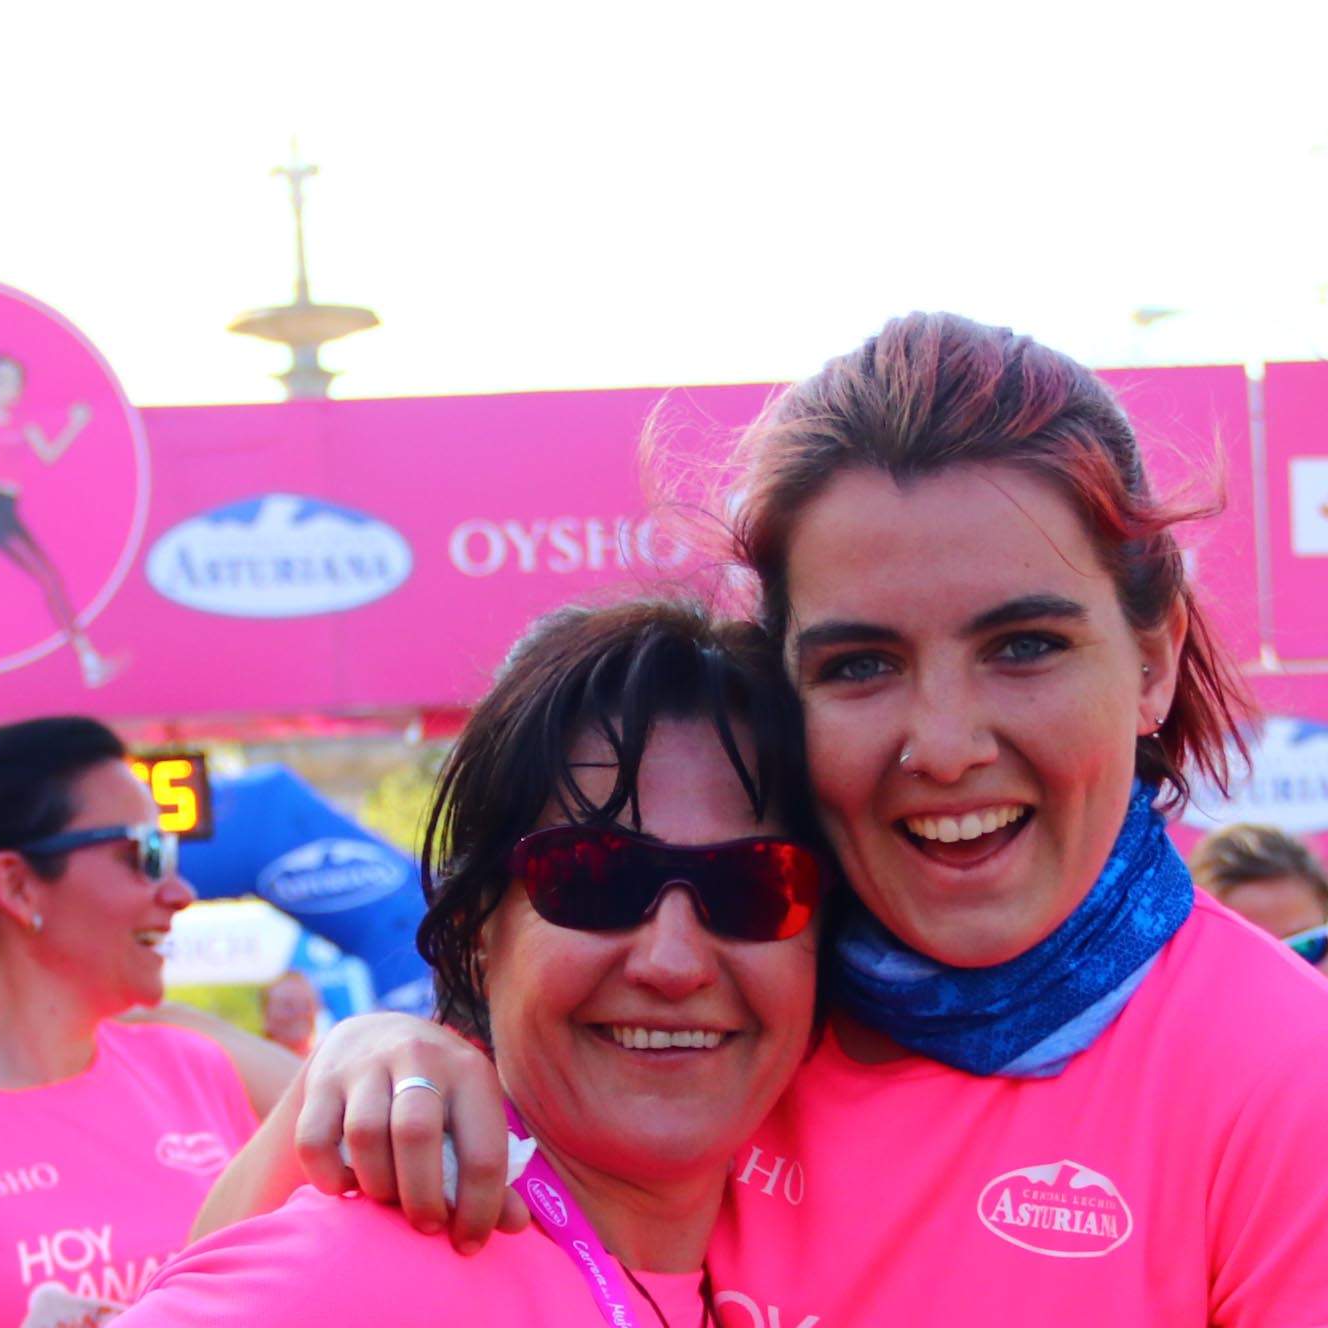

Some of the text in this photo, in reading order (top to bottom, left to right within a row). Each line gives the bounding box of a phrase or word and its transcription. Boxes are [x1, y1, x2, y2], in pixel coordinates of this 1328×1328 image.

[172, 552, 394, 592] ASTURIANA
[448, 516, 692, 578] OYSHO
[988, 1186, 1120, 1240] ASTURIANA
[17, 1224, 113, 1286] HOY
